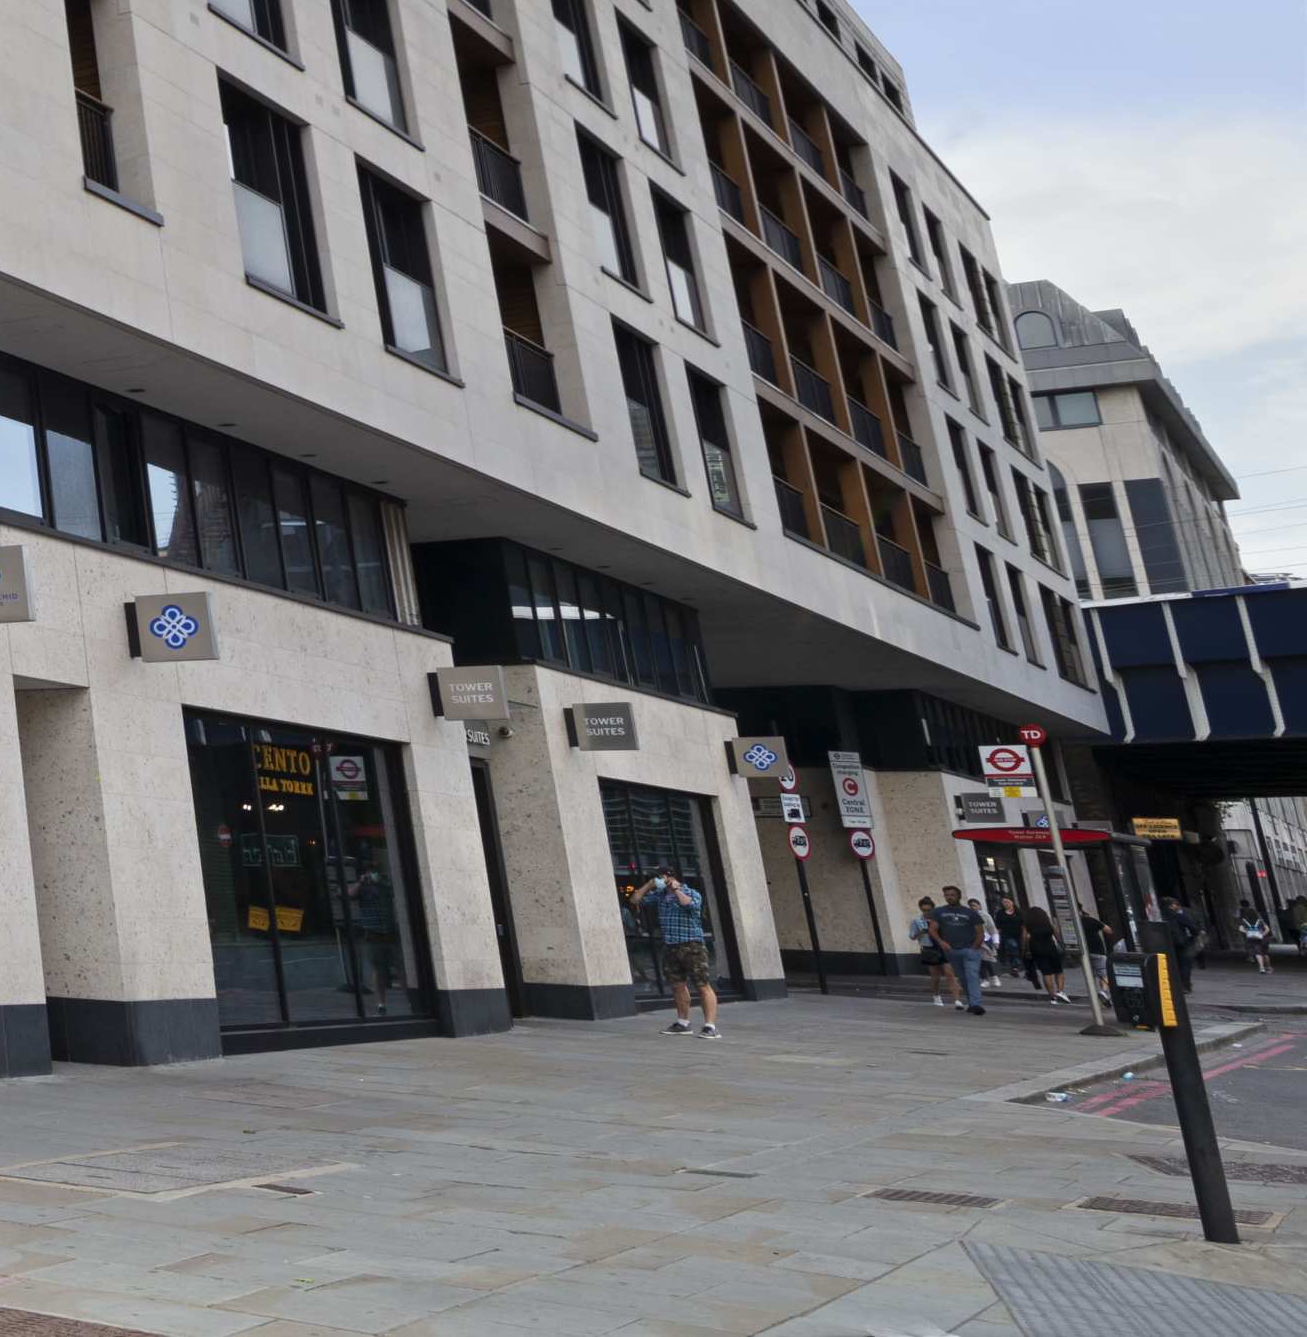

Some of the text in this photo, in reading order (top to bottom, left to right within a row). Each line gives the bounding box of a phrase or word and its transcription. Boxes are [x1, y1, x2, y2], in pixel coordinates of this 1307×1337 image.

[449, 682, 492, 693] TOWER
[450, 694, 494, 704] SUITES
[584, 717, 624, 726] TOWER
[586, 727, 626, 736] SUITES
[1021, 730, 1041, 740] TD
[467, 729, 491, 745] SUITES
[251, 744, 311, 775] CENTO
[259, 776, 279, 791] LLA
